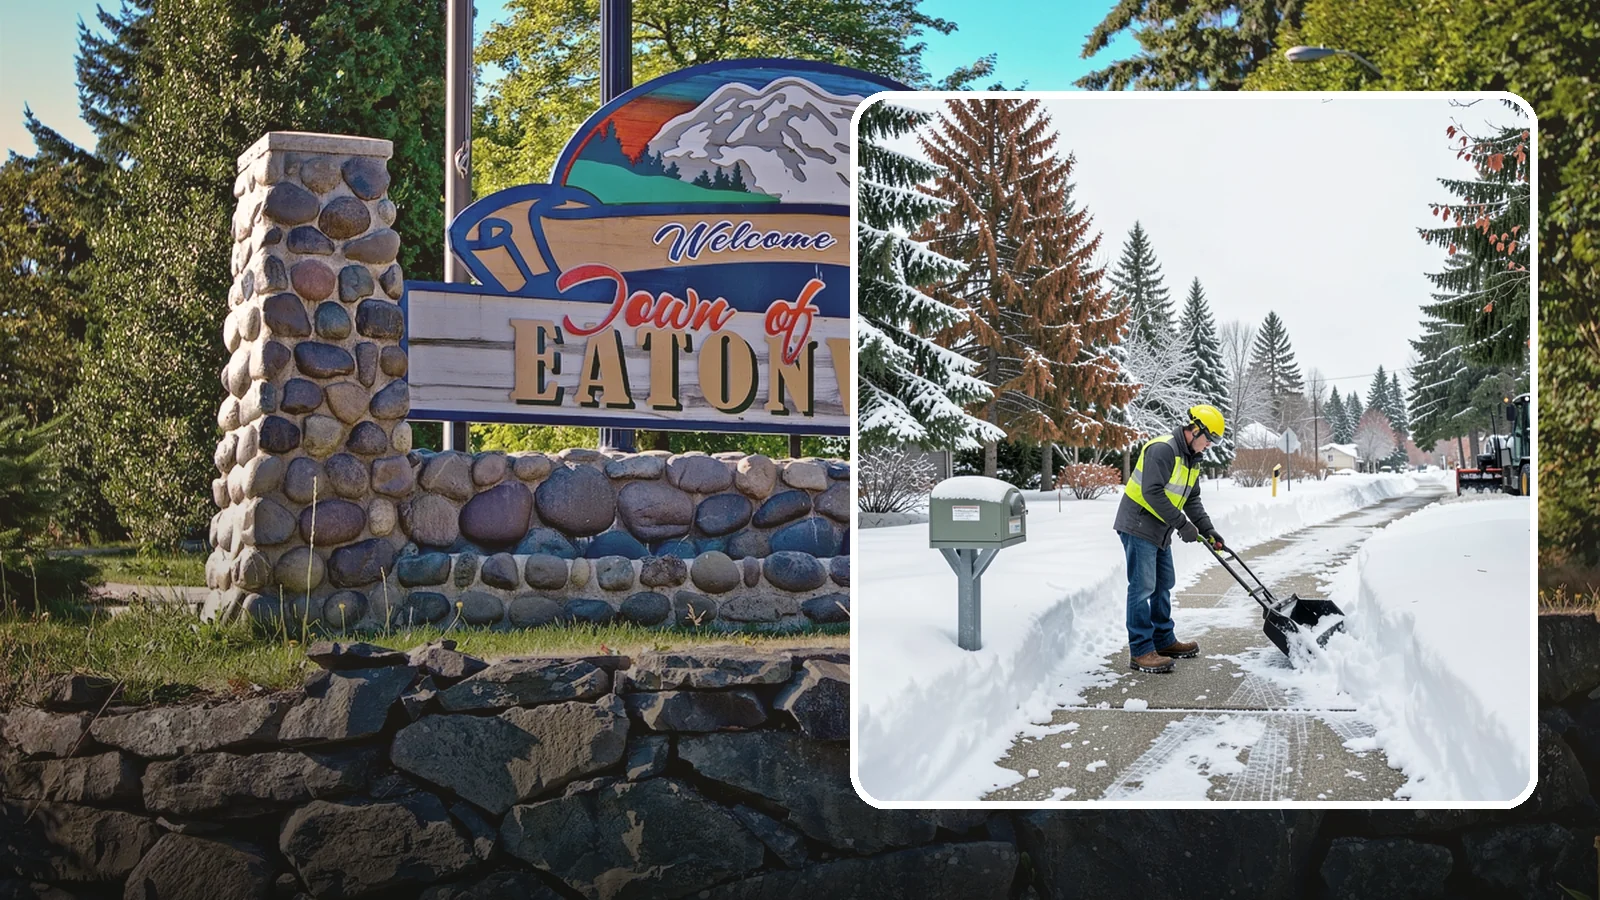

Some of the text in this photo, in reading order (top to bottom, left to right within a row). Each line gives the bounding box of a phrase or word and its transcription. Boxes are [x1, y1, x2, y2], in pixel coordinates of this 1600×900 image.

[653, 220, 837, 264] Welcome
[556, 262, 826, 366] Town of
